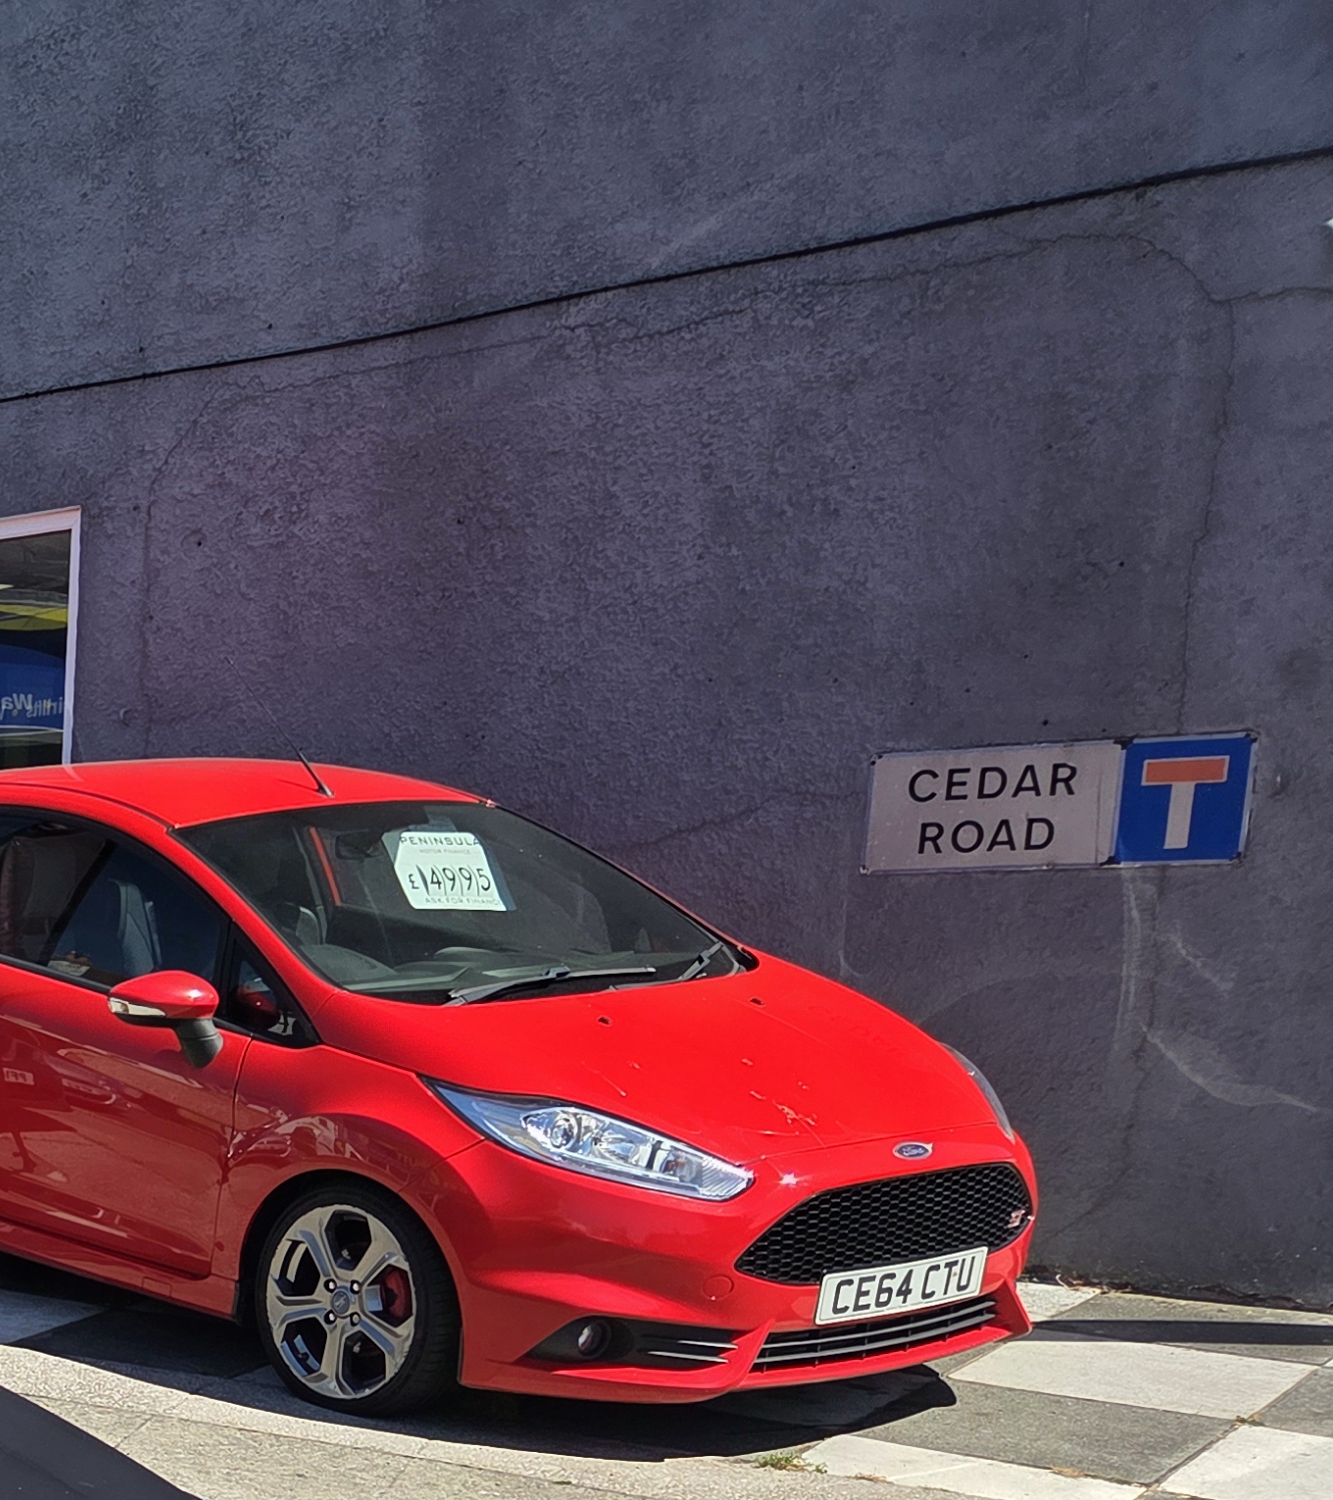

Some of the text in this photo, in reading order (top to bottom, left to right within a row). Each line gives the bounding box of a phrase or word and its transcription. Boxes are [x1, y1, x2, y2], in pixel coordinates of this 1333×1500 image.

[907, 762, 1078, 803] CEDAR
[400, 836, 480, 846] PENINSULA
[917, 817, 1055, 855] ROAD
[831, 1256, 977, 1315] CE64 CTU
